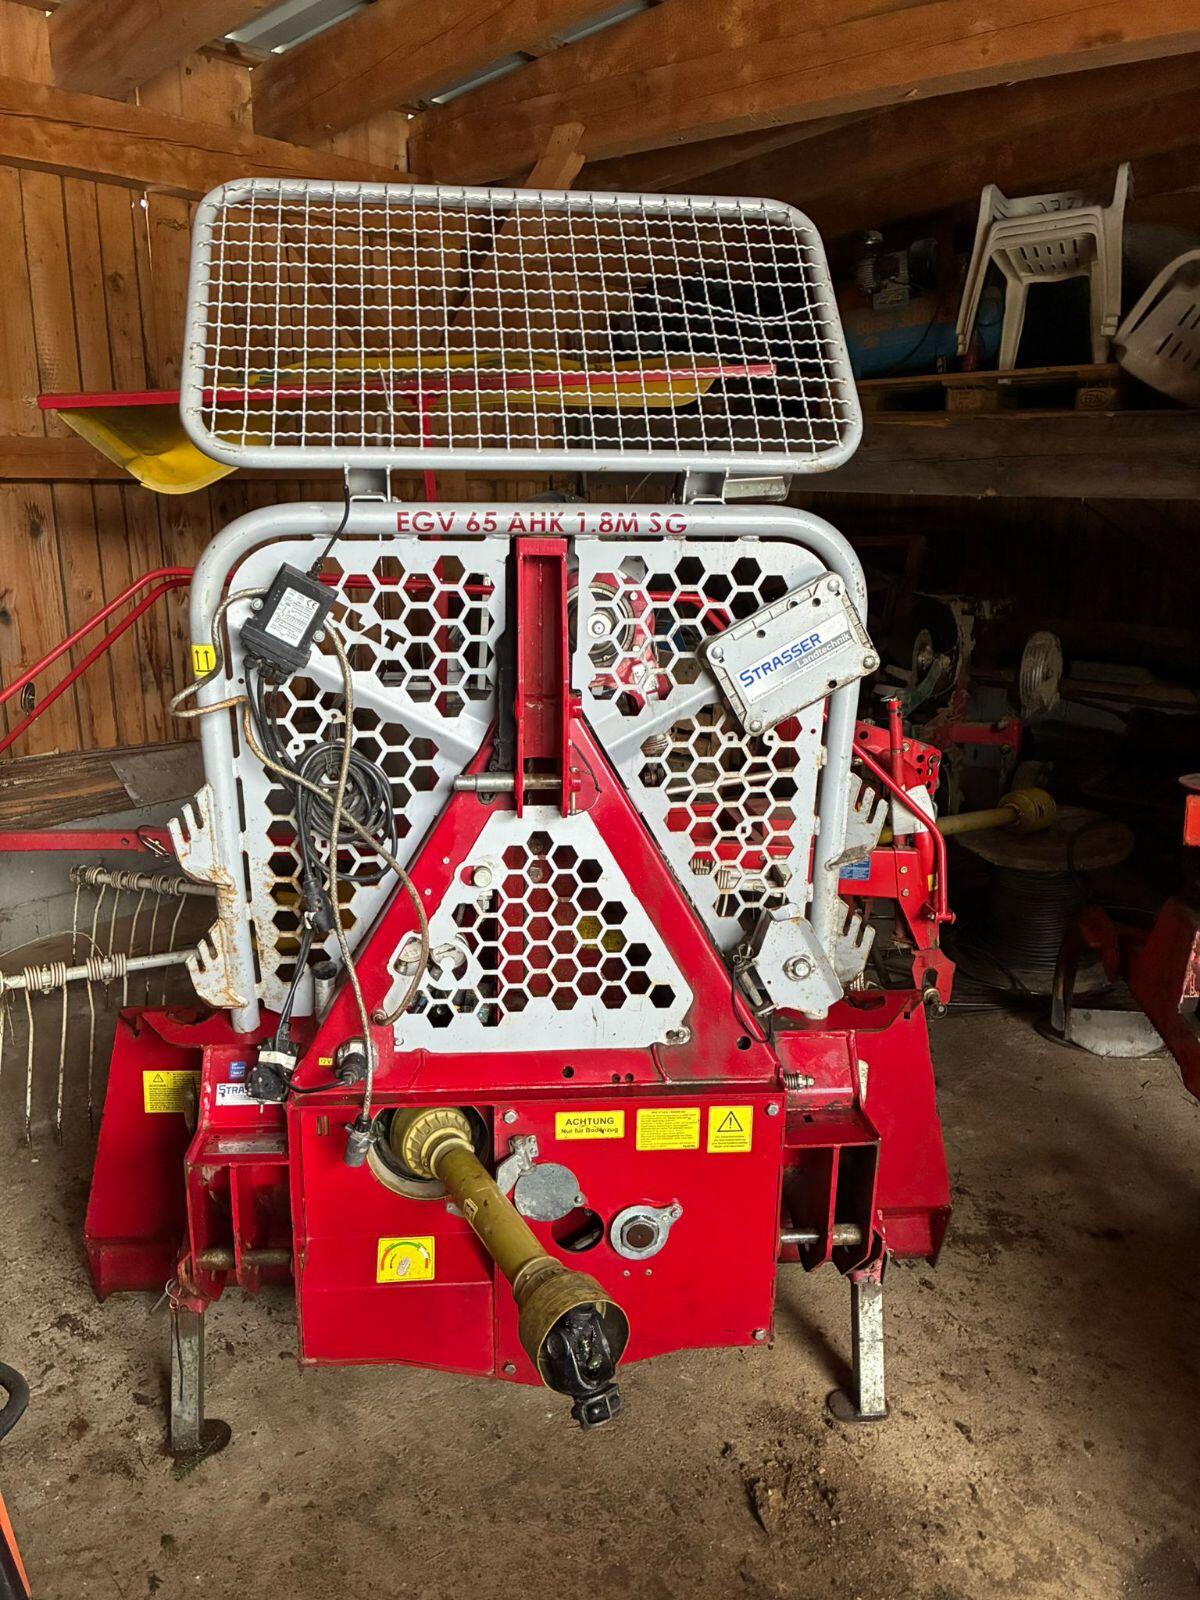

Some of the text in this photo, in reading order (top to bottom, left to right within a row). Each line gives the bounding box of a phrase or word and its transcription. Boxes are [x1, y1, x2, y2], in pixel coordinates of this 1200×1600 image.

[396, 511, 688, 533] EGV 65 AHK 1.8M SG
[739, 632, 823, 688] STRASSER
[796, 631, 851, 667] Landtechnik
[218, 1085, 246, 1095] STRA
[565, 1117, 615, 1126] ACHTUNG
